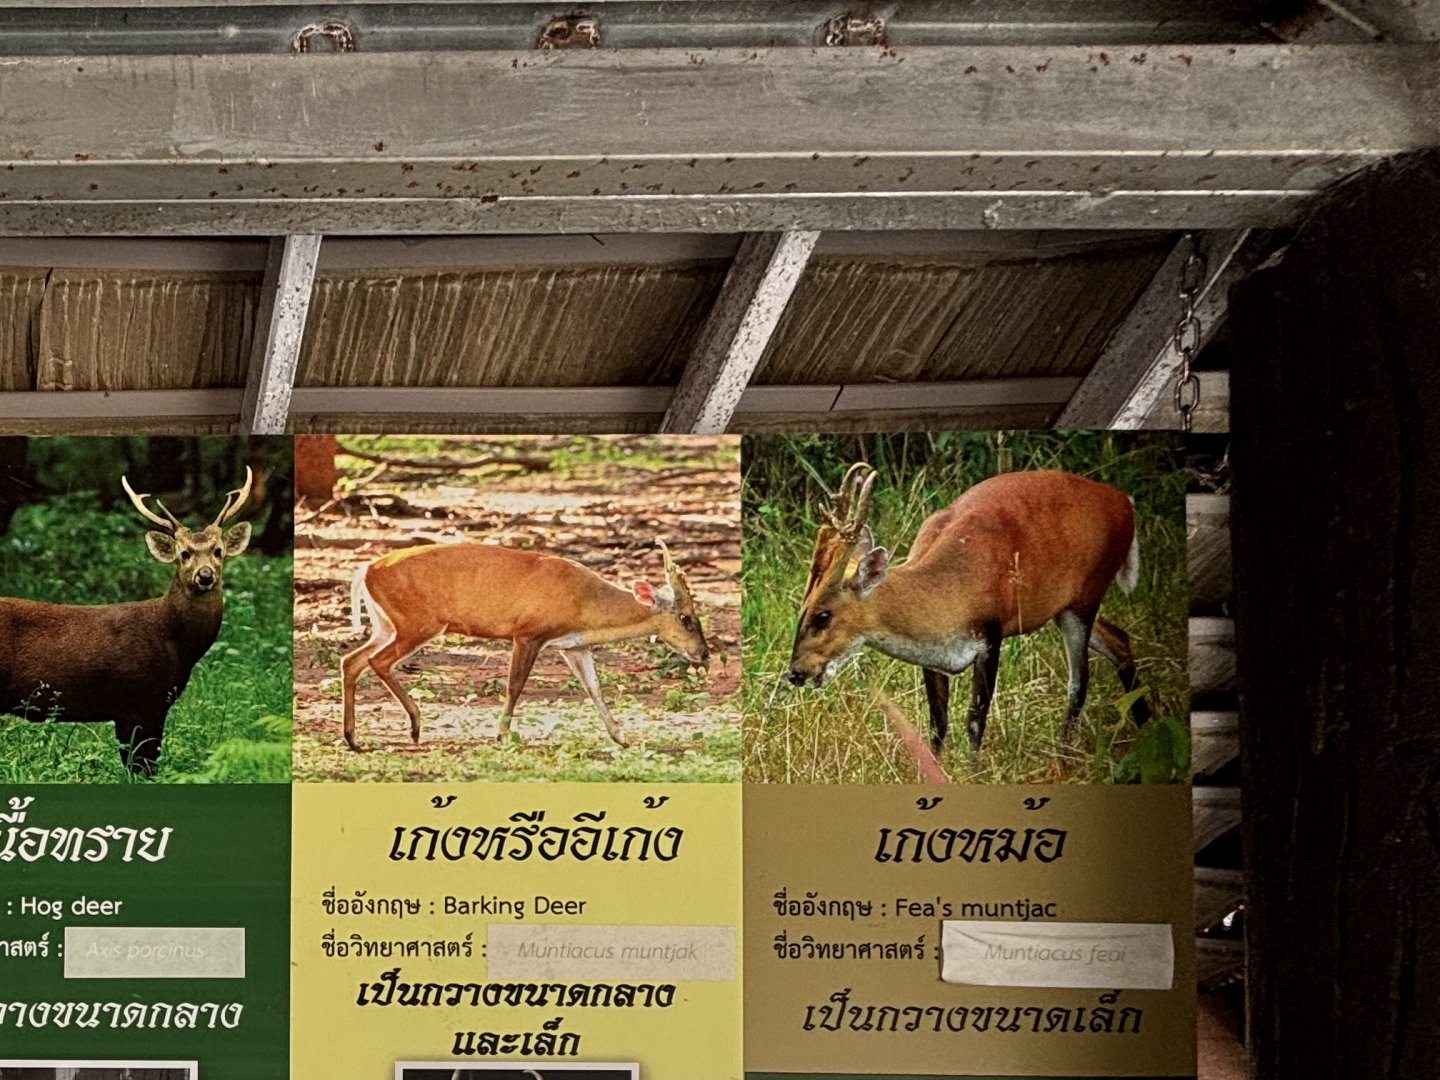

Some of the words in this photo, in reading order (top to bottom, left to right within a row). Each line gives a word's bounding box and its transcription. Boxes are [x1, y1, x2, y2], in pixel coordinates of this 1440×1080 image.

[389, 796, 684, 861] เก้งหรืออีเก้ง
[875, 797, 1067, 863] เก้งหม้อ
[22, 897, 62, 920] Hog
[72, 896, 122, 915] deer
[322, 886, 421, 919] ชื่ออังกฤษ
[445, 896, 524, 919] Barking
[535, 896, 586, 915] Deer
[773, 887, 872, 921] ชื่ออังกฤษ
[896, 897, 952, 917] Fea's
[962, 897, 1057, 921] muntjac
[322, 928, 473, 957] ชื่อวิทยาศาสตร์
[517, 942, 613, 960] Muntiacus
[621, 942, 699, 963] muntjak
[774, 930, 925, 960] ชื่อวิทยาศาสตร์
[357, 967, 676, 1007] เป็นกวางขนาดกลาง
[803, 988, 1142, 1034] เป็นกวางขนาดเล็ก
[452, 1017, 581, 1056] และเล็ก
